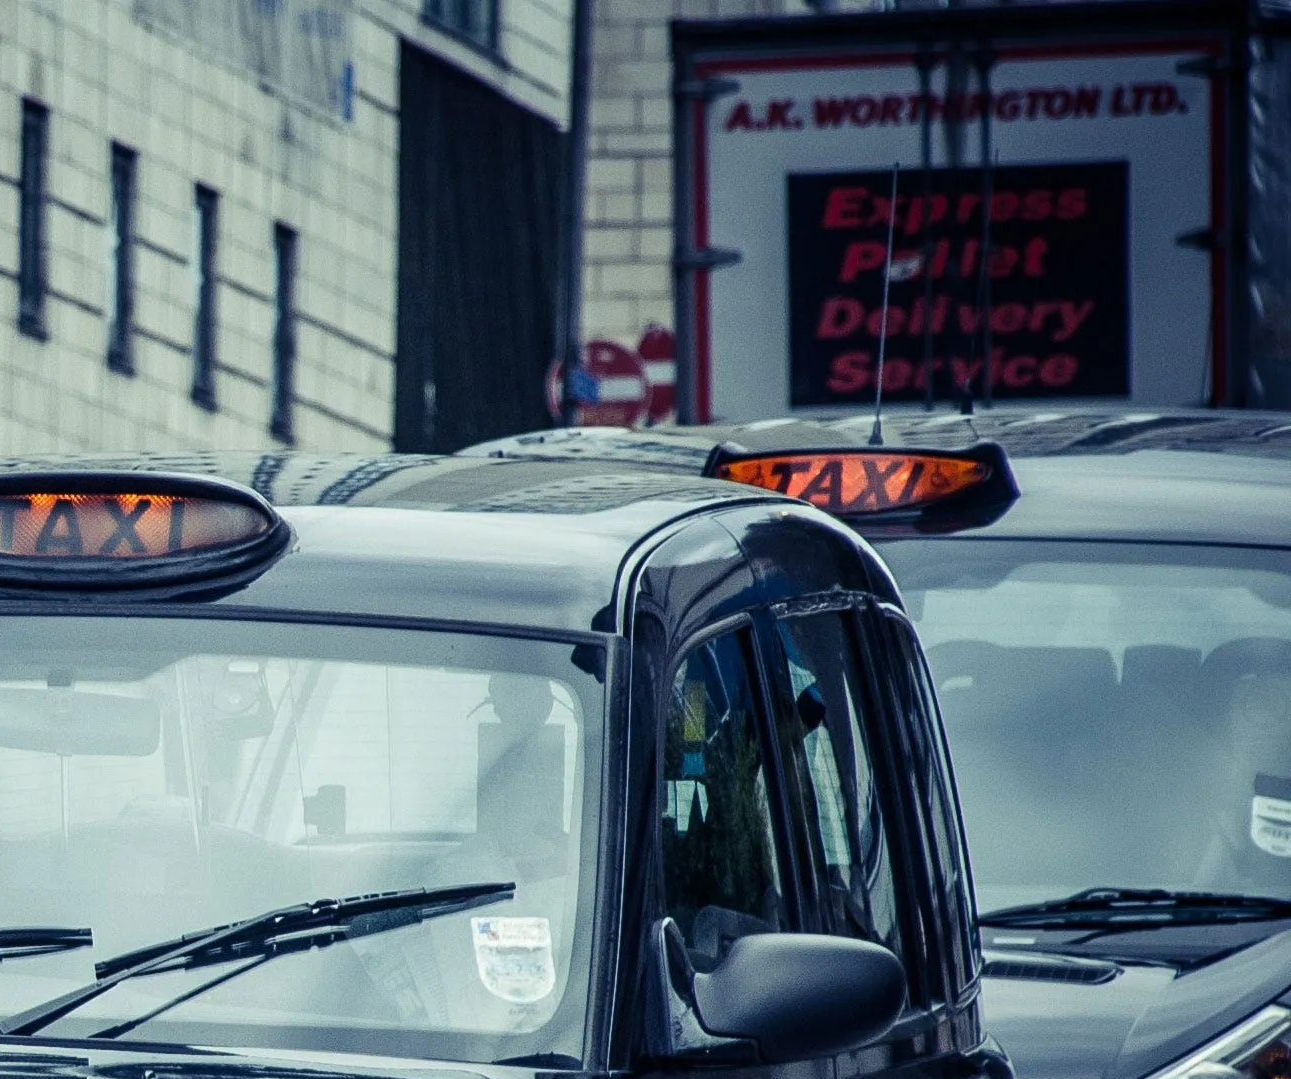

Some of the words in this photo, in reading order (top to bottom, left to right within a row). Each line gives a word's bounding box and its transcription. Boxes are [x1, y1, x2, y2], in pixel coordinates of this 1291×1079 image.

[724, 98, 804, 133] A.K.
[1110, 80, 1188, 117] LTD.
[823, 186, 1088, 235] Express
[816, 296, 1095, 341] Delivery
[826, 347, 1079, 393] Service
[771, 458, 925, 511] TAXI
